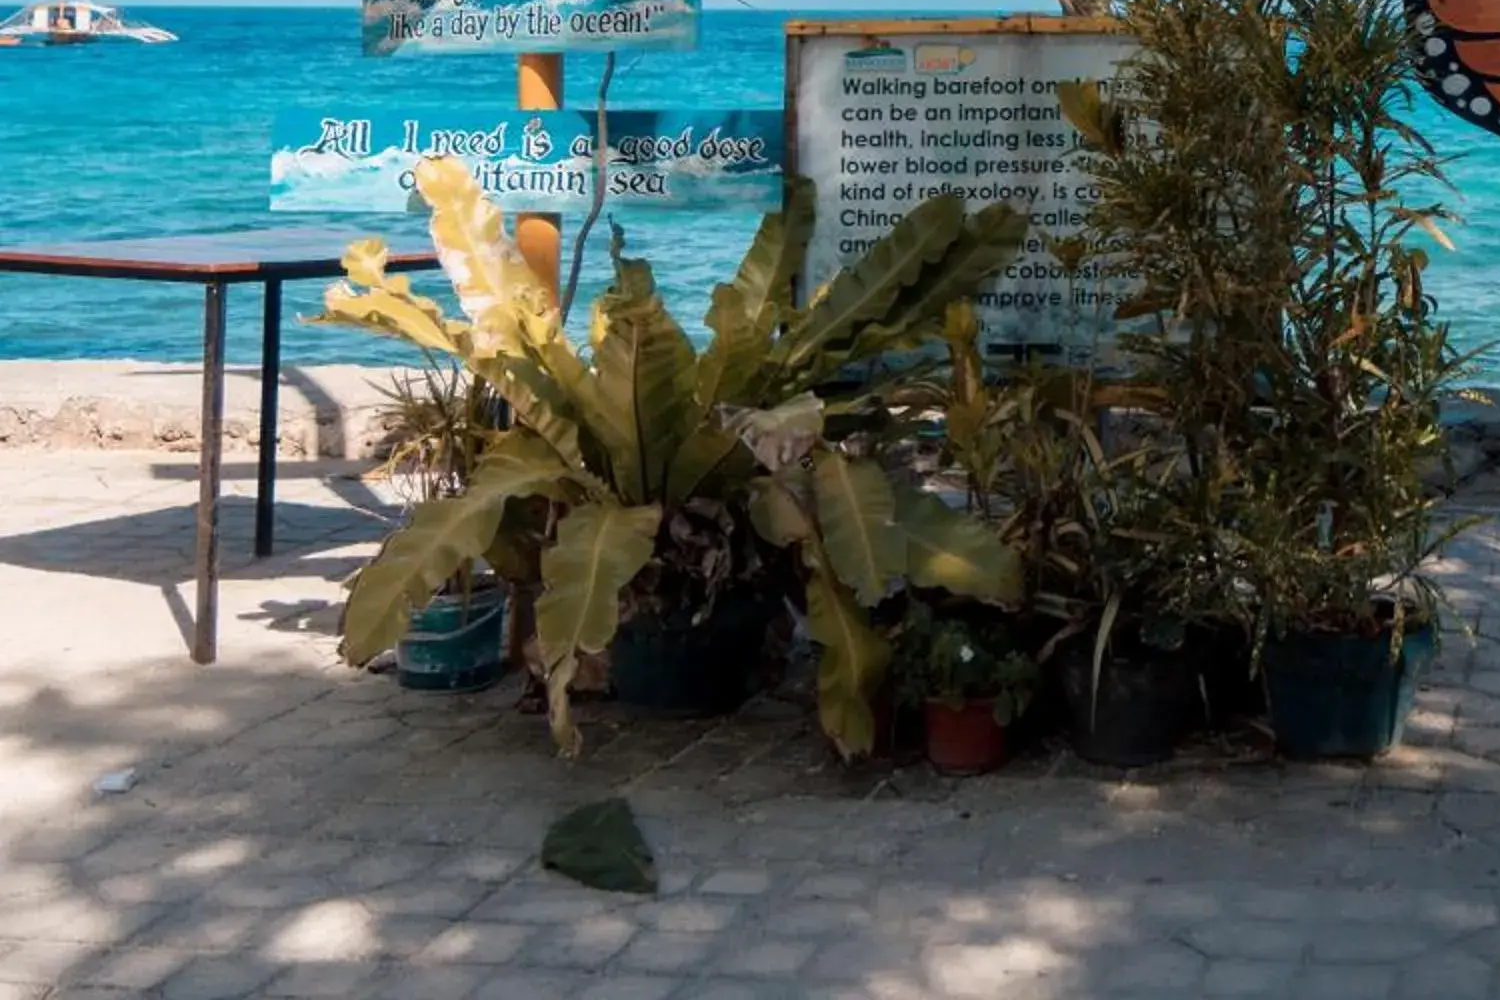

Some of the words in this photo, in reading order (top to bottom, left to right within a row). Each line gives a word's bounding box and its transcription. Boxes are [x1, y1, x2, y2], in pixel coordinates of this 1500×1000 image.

[390, 11, 426, 40] like
[432, 15, 444, 37] a
[451, 10, 490, 41] day
[495, 6, 519, 39] by
[526, 4, 561, 35] the
[842, 77, 927, 98] Walking
[933, 77, 1025, 95] barefoot
[1031, 80, 1057, 94] on
[841, 108, 883, 121] can
[889, 104, 918, 121] be
[924, 108, 952, 121] an
[299, 119, 369, 161] All
[404, 120, 418, 152] I
[430, 122, 507, 157] need
[523, 124, 551, 157] is
[570, 136, 592, 157] a
[610, 127, 693, 164] good
[698, 126, 767, 160] dose
[841, 130, 913, 149] health,
[921, 130, 1019, 150] including
[1026, 130, 1065, 147] less
[840, 157, 899, 174] lower
[905, 156, 968, 174] blood
[974, 157, 1071, 176] pressure.
[474, 162, 586, 195] itamin
[609, 170, 667, 195] sea
[840, 183, 886, 200] kind
[893, 184, 913, 200] of
[1053, 182, 1068, 200] is
[976, 288, 1062, 309] mprove
